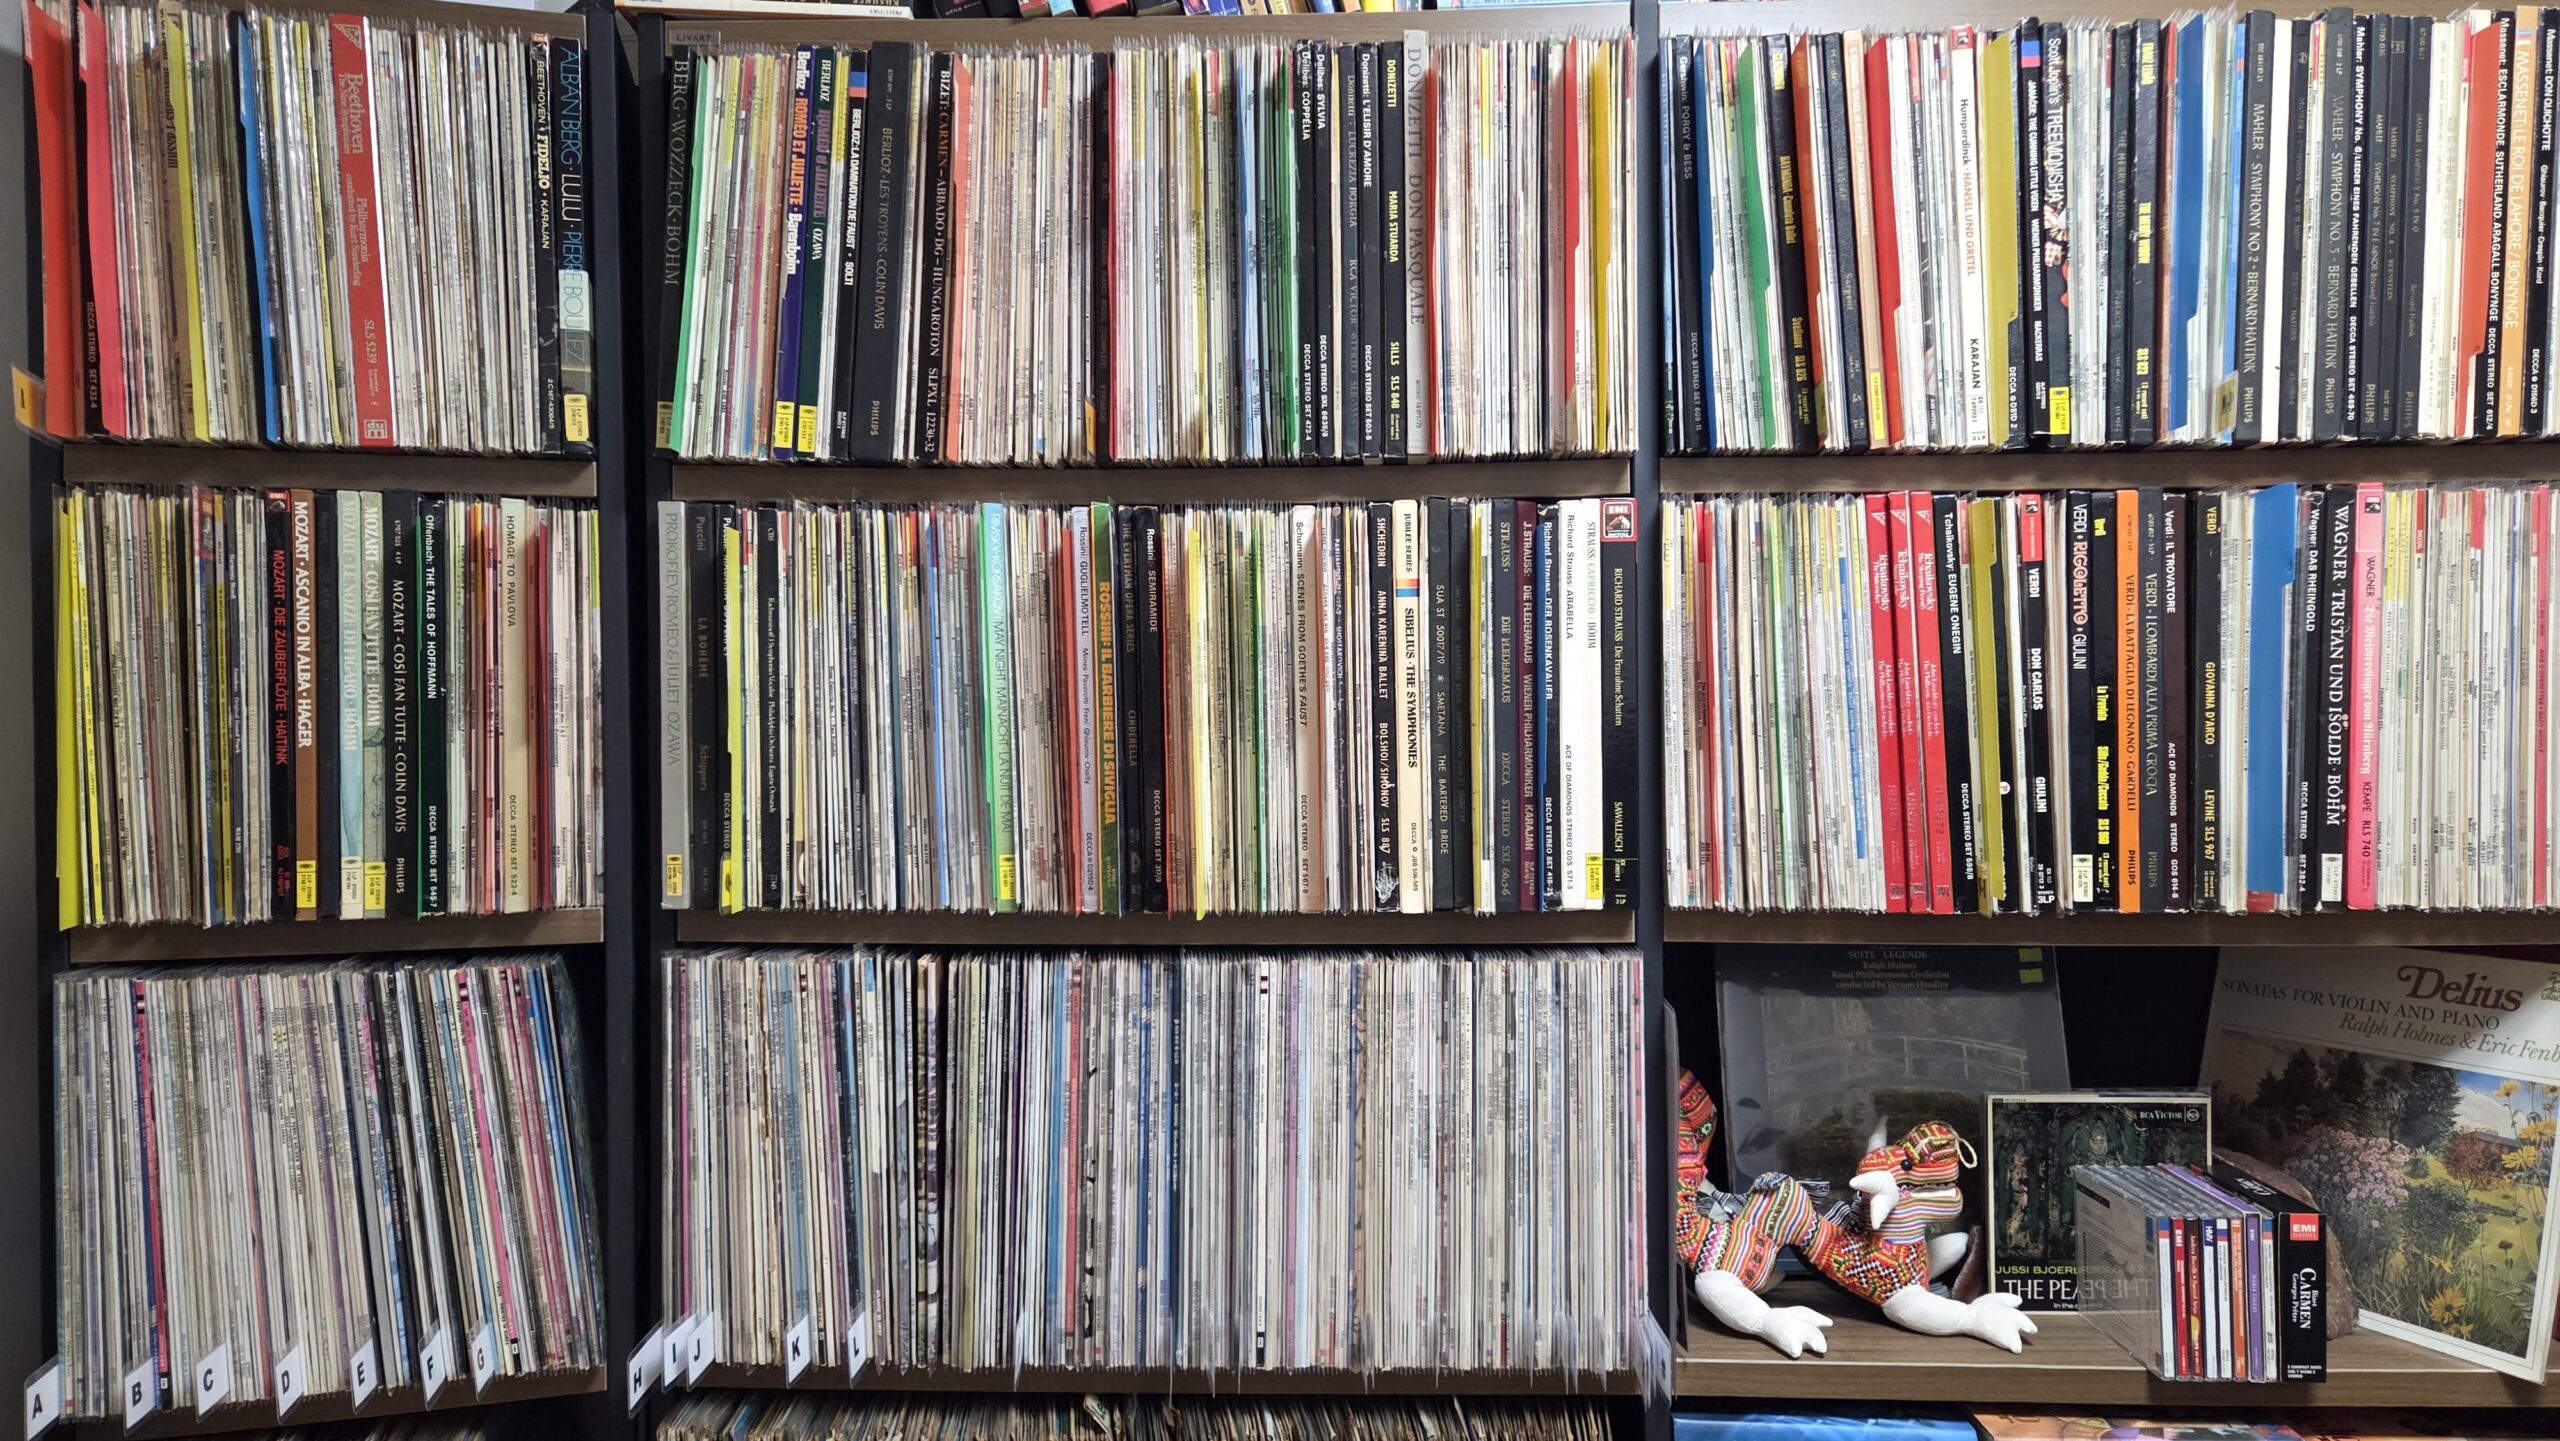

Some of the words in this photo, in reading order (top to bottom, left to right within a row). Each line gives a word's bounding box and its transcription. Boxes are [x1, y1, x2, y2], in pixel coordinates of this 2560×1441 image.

[676, 34, 712, 42] LIVART
[2047, 38, 2063, 64] Scott
[339, 73, 349, 88] The
[560, 47, 581, 118] ALBAN
[672, 60, 688, 110] BERG
[796, 51, 810, 89] Berlioz
[1387, 60, 1396, 107] DONIZETTI
[2045, 66, 2064, 104] Joplin's
[340, 91, 349, 107] Nine
[536, 61, 546, 123] BEETHOVEN
[939, 70, 950, 110] BIZET:
[1407, 48, 1423, 158] DONIZETTI
[2513, 51, 2527, 129] MASSENET:
[340, 109, 353, 154] Symphonies
[347, 72, 365, 153] Beethoven
[1960, 99, 1972, 165] Humperdinck
[2252, 104, 2264, 150] MAHLER
[560, 121, 581, 164] BERG
[793, 139, 806, 153] ET
[937, 112, 949, 167] CARMEN
[2046, 106, 2064, 203] TREEMONISHA
[2512, 131, 2526, 144] LE
[537, 134, 549, 189] FIDELIO
[669, 120, 685, 218] WOZZECK
[2511, 147, 2525, 170] ROI
[345, 174, 357, 212] conducted
[562, 174, 581, 220] LULU
[789, 155, 805, 205] JULIETTE
[1408, 174, 1424, 218] DON
[1963, 173, 1974, 212] HANSEL
[2249, 163, 2263, 227] SYMPHONY
[2510, 175, 2524, 192] DE
[540, 200, 550, 248] KARAJAN
[935, 179, 946, 230] ABBADO
[1389, 191, 1398, 220] MARIA
[350, 224, 360, 244] Kurt
[356, 198, 369, 262] Philharmonia
[786, 213, 802, 274] Barenboim
[1389, 223, 1399, 262] STUARDA
[1964, 215, 1974, 237] UND
[2248, 232, 2261, 254] NO.
[349, 245, 363, 286] Sanderling
[563, 231, 583, 280] PIERRE
[665, 226, 683, 285] BÖHM
[933, 237, 944, 255] DG
[1966, 241, 1977, 276] GRETEL
[1408, 227, 1425, 325] PASQUALE
[930, 267, 943, 356] HUNGAROTON
[2245, 272, 2258, 324] BERNARD
[364, 319, 376, 338] SLS
[563, 286, 584, 362] BOULEZ
[366, 339, 377, 363] 5239
[1970, 338, 1981, 388] KARAJAN
[2243, 326, 2258, 372] HAITINK
[89, 369, 97, 382] SET
[927, 368, 938, 406] SLPXL
[89, 385, 97, 408] 433-4
[2244, 387, 2255, 423] PHILIPS
[925, 412, 937, 452] 12230-32
[295, 502, 312, 559] MOZART
[426, 515, 435, 564] Offenbach:
[506, 515, 516, 559] HOMAGE
[2206, 507, 2216, 534] VERDI
[1295, 522, 1305, 570] Schumann:
[1942, 513, 1957, 571] Tchaikovsky:
[2333, 505, 2349, 581] WAGNER
[426, 567, 435, 586] THE
[507, 564, 516, 578] TO
[1614, 568, 1624, 605] RICHARD
[2028, 568, 2040, 597] VERDI
[295, 567, 312, 633] ASCANIO
[426, 589, 435, 620] TALES
[507, 581, 516, 627] PAVLOVA
[1296, 574, 1306, 611] SCENES
[1948, 574, 1960, 613] EUGENE
[427, 624, 436, 638] OF
[1100, 582, 1113, 646] ROSSINI:
[1297, 614, 1307, 643] FROM
[1404, 608, 1416, 658] SIBELIUS
[1614, 607, 1624, 642] STRAUSS
[2328, 589, 2346, 661] TRISTAN
[296, 635, 312, 654] IN
[1101, 648, 1114, 660] IL
[1614, 645, 1623, 658] Die
[1950, 615, 1962, 654] ONEGIN
[297, 655, 313, 692] ALBA
[427, 641, 437, 699] HOFFMANN
[1298, 646, 1307, 693] GOETHE'S
[1406, 666, 1417, 688] THE
[1614, 659, 1623, 675] Frau
[2030, 648, 2042, 669] DON
[1101, 662, 1115, 739] BARBIERE
[1614, 675, 1623, 694] ohne
[2030, 673, 2043, 710] CARLOS
[2205, 662, 2216, 709] GIOVANNA
[2327, 664, 2343, 703] UND
[297, 699, 313, 747] HAGER
[1298, 695, 1308, 726] FAUST
[1406, 691, 1418, 768] SYMPHONIES
[1614, 695, 1624, 726] Schatten
[2205, 712, 2216, 744] D'ARCO
[1102, 743, 1116, 759] DI
[2327, 707, 2343, 765] ISOLDE
[1103, 761, 1117, 824] SIVIGLIA
[2034, 777, 2047, 813] GIULINI
[2325, 774, 2343, 826] BÖHM
[1613, 802, 1624, 852] SAWALLISCH
[2221, 979, 2287, 1000] SONATAS
[2293, 989, 2324, 1006] FOR
[2327, 994, 2391, 1015] VIOLIN
[2394, 1004, 2435, 1021] AND
[2442, 1010, 2500, 1030] PIANO
[2397, 964, 2524, 1012] Delius
[2338, 1012, 2390, 1038] Ralph
[2392, 1021, 2457, 1047] Holmes
[2459, 1032, 2476, 1049] &
[2477, 1033, 2518, 1056] Eric
[2518, 1039, 2560, 1063] Fenb
[2139, 1111, 2154, 1119] RCA
[2175, 1229, 2183, 1247] EMI
[2292, 1224, 2316, 1232] EMI
[1995, 1266, 2029, 1275] JUSSI
[2033, 1266, 2078, 1275] BJOERL
[2003, 1280, 2044, 1300] THE
[2291, 1273, 2299, 1299] Georges
[2300, 1267, 2317, 1329] CARMEN
[693, 1338, 700, 1363] J
[791, 1336, 801, 1361] K
[203, 1368, 214, 1391] C
[281, 1371, 290, 1394] D
[357, 1362, 365, 1387] E
[427, 1356, 434, 1381] F
[632, 1365, 642, 1394] H
[32, 1394, 42, 1419] A
[132, 1381, 142, 1406] B
